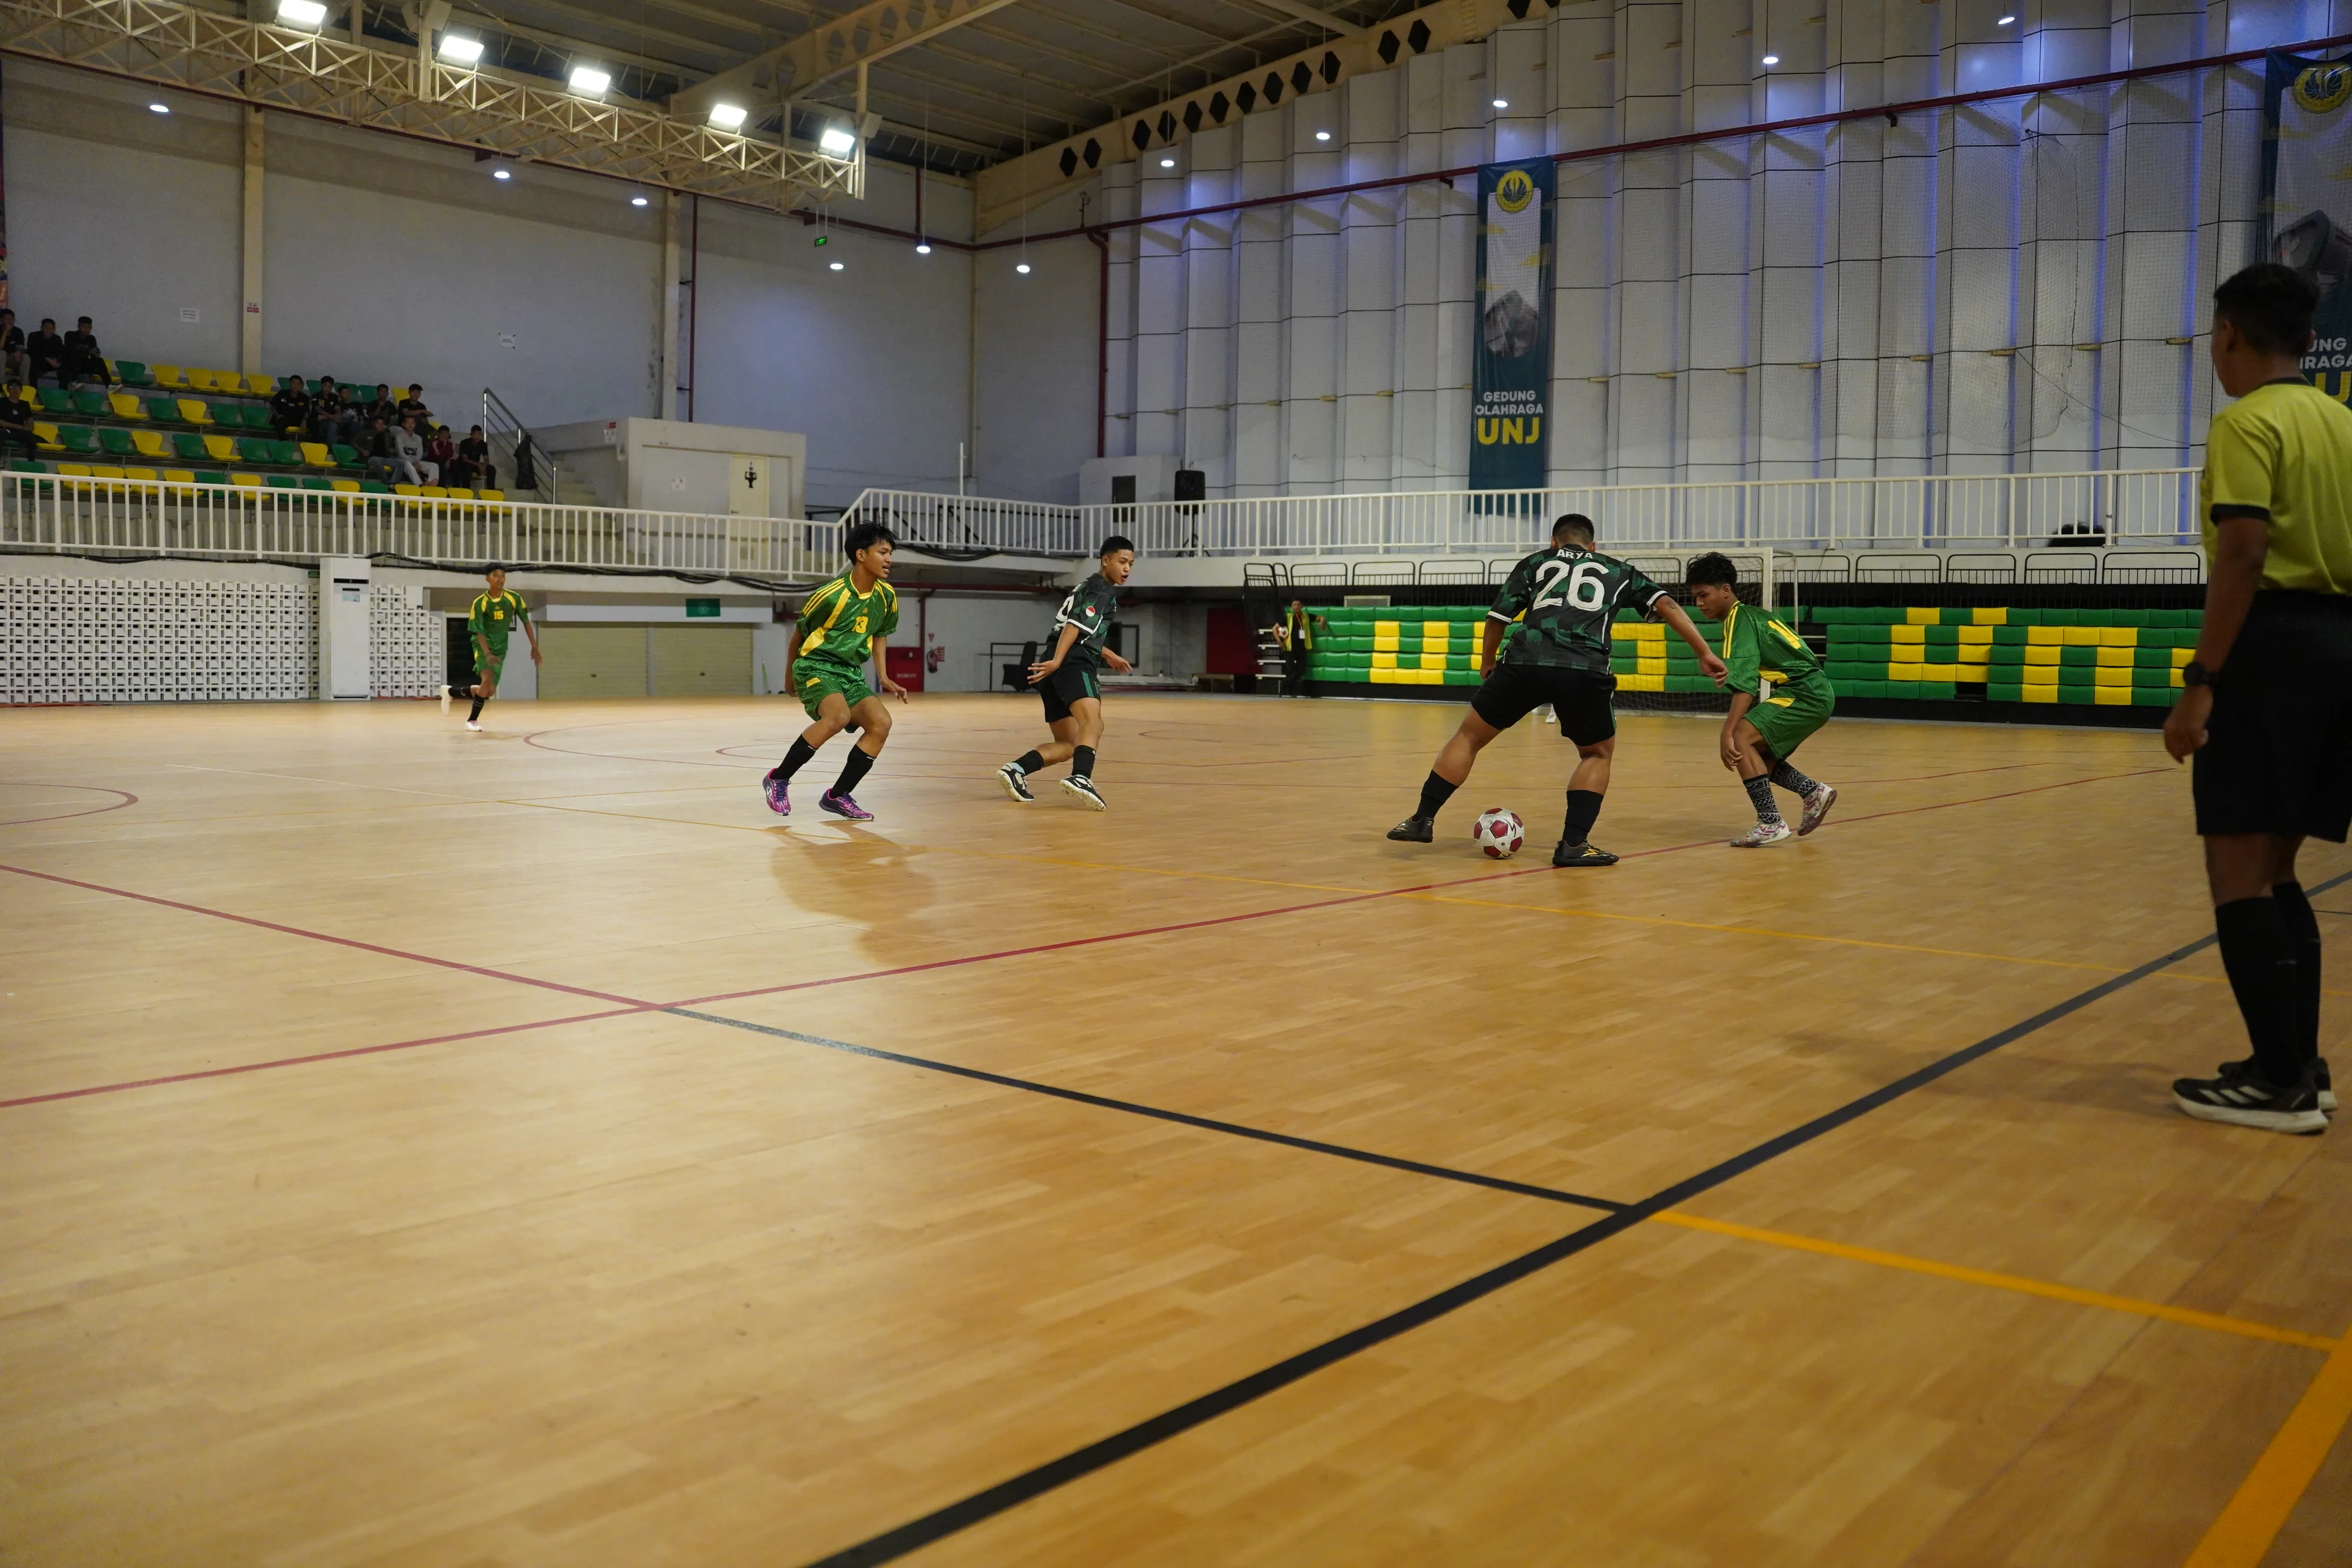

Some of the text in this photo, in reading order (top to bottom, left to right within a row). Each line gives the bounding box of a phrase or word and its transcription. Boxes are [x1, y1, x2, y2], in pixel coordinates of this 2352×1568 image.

[1483, 390, 1536, 402] GEDUNG
[1475, 403, 1544, 415] OLAHRAGA
[1477, 416, 1540, 445] UNJ
[1556, 549, 1593, 559] ARYA
[1532, 560, 1609, 612] 26
[493, 610, 504, 620] 15
[851, 615, 869, 633] 13
